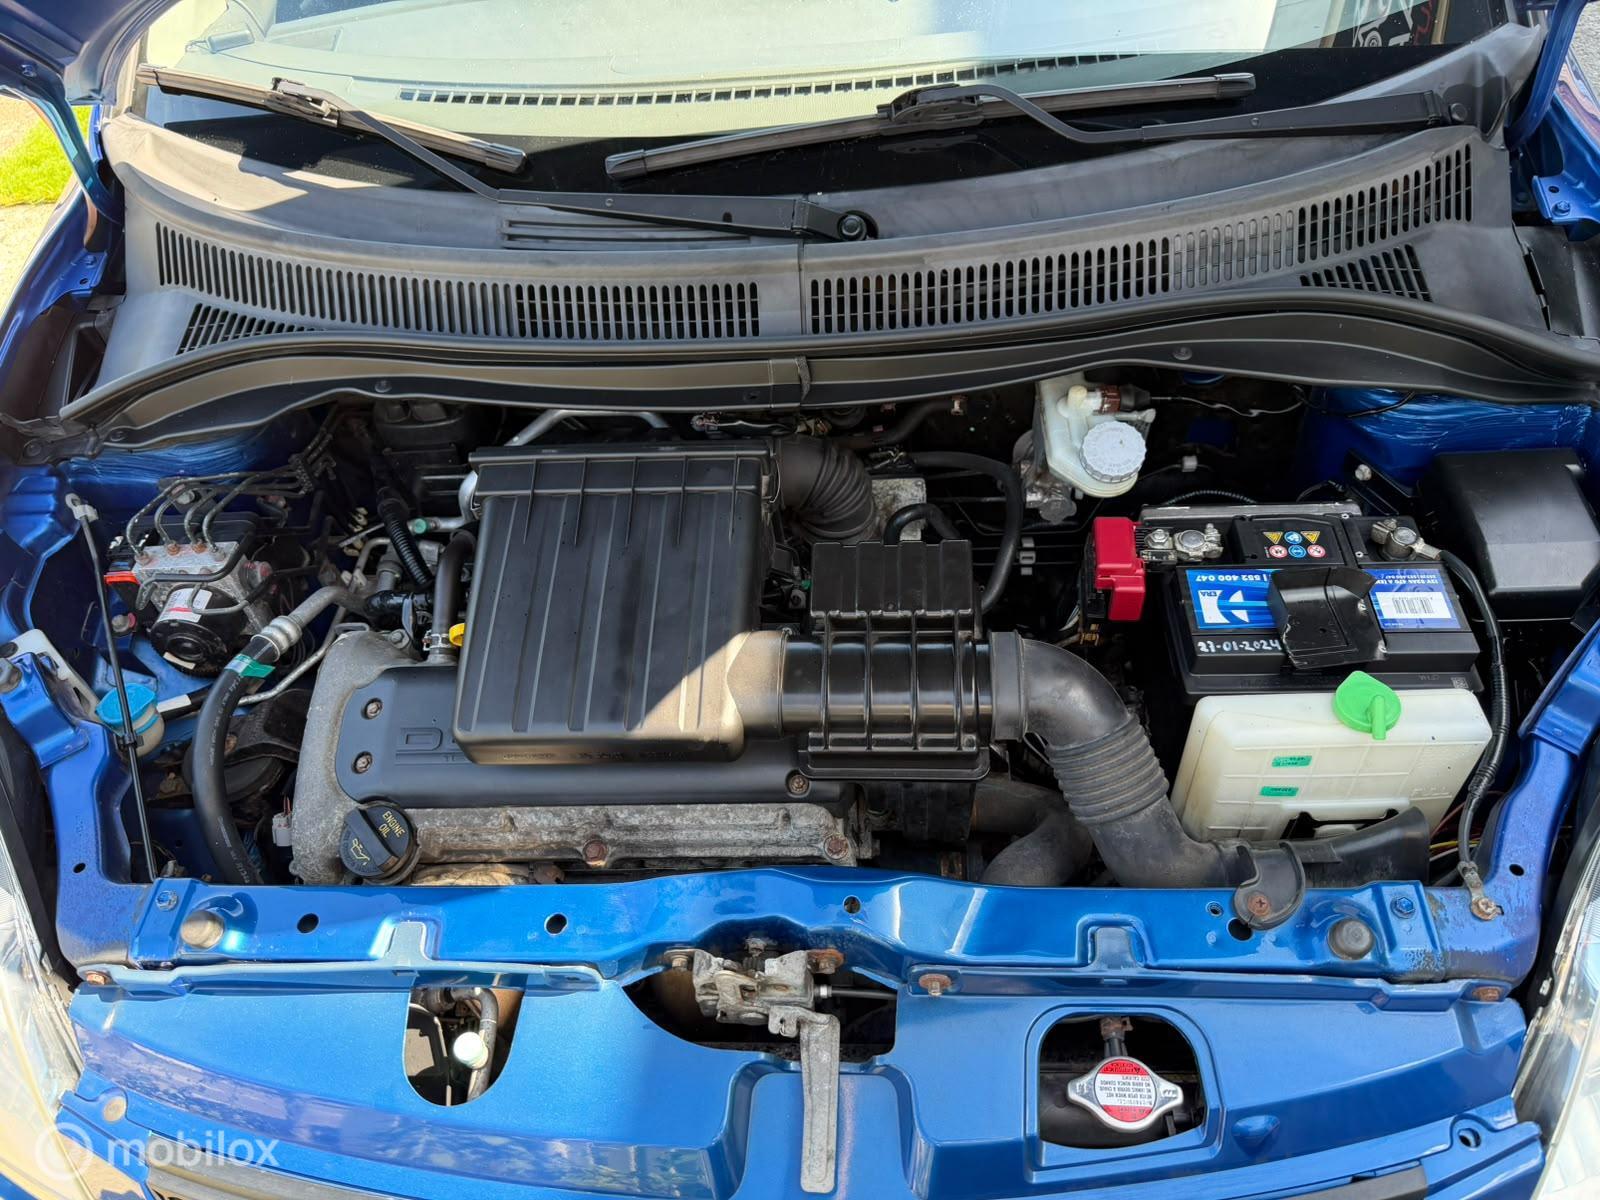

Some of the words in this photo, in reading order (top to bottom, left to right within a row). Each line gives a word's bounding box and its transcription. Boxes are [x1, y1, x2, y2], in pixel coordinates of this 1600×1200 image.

[1198, 640, 1282, 652] 27-01-2024
[379, 823, 391, 838] OIL
[383, 811, 405, 838] ENGINE
